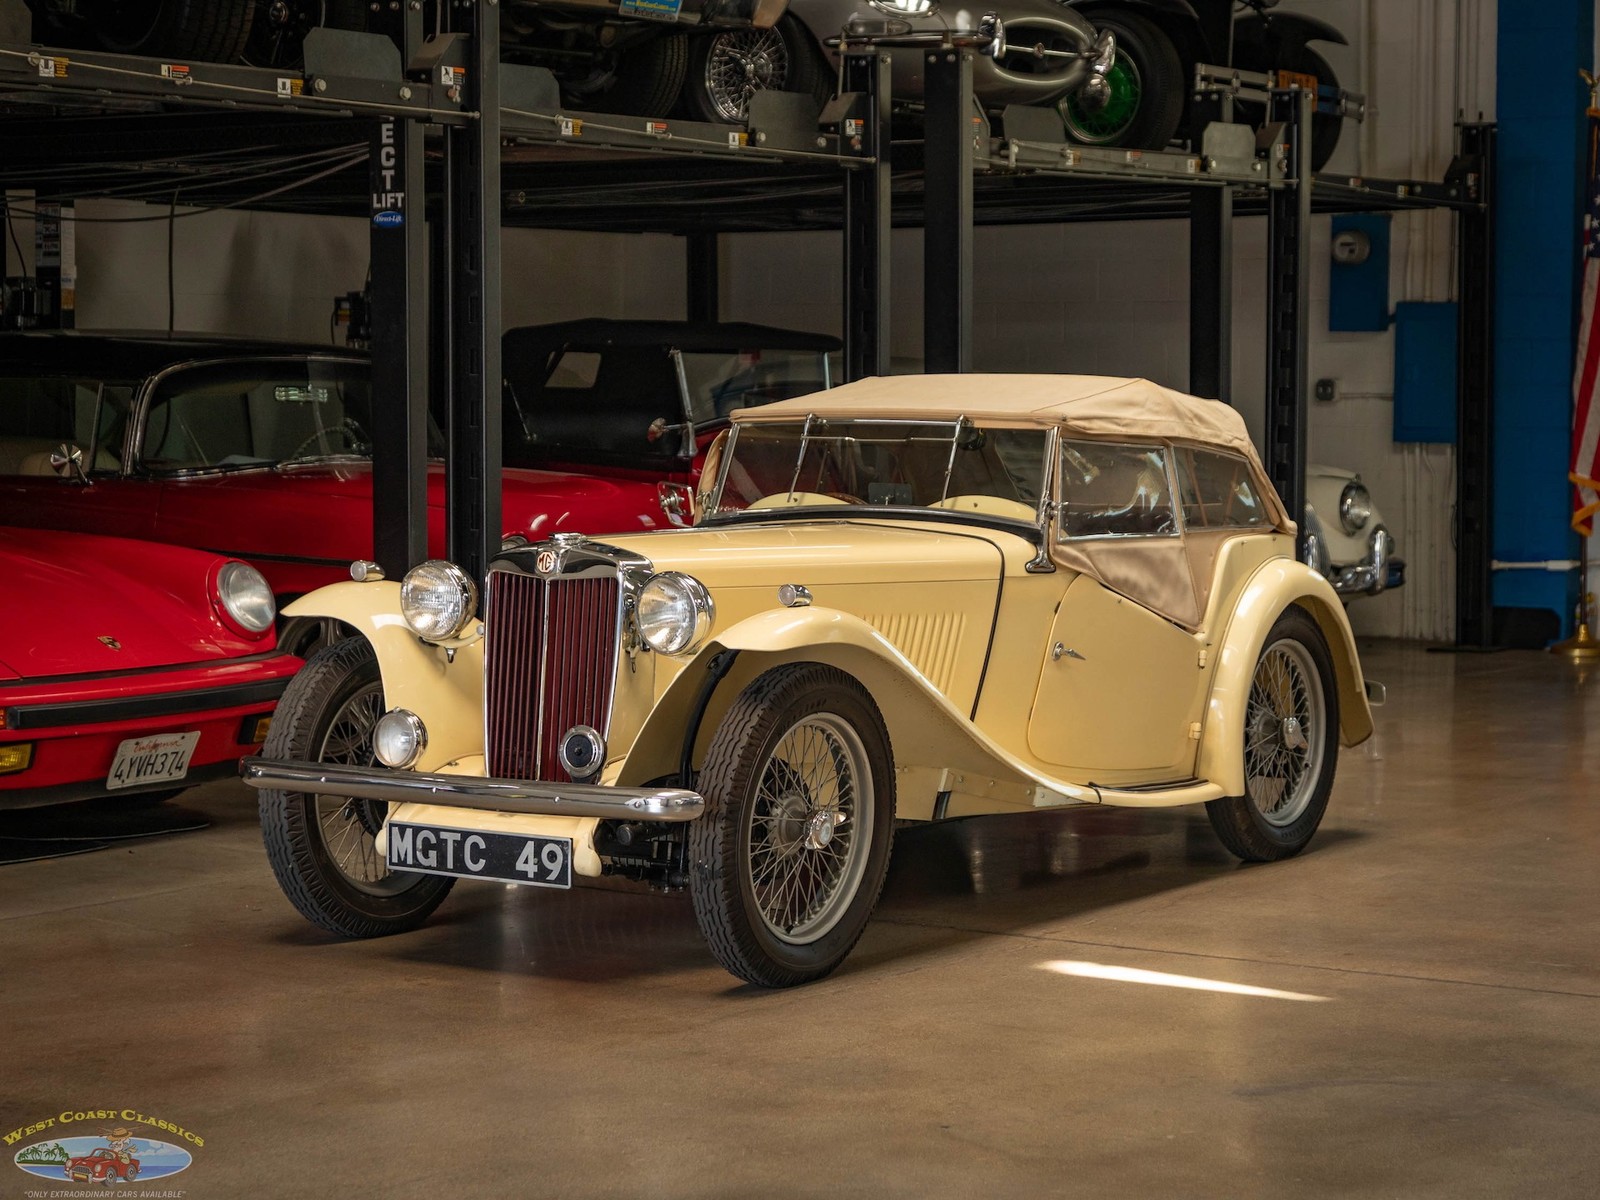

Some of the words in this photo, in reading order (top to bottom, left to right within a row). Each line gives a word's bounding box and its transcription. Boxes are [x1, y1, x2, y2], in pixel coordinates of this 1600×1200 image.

[380, 115, 396, 190] ECT
[372, 192, 405, 209] LIFT
[538, 552, 554, 572] MG
[114, 750, 186, 780] 4YVH374
[391, 826, 487, 873] MGTC
[515, 840, 564, 881] 49
